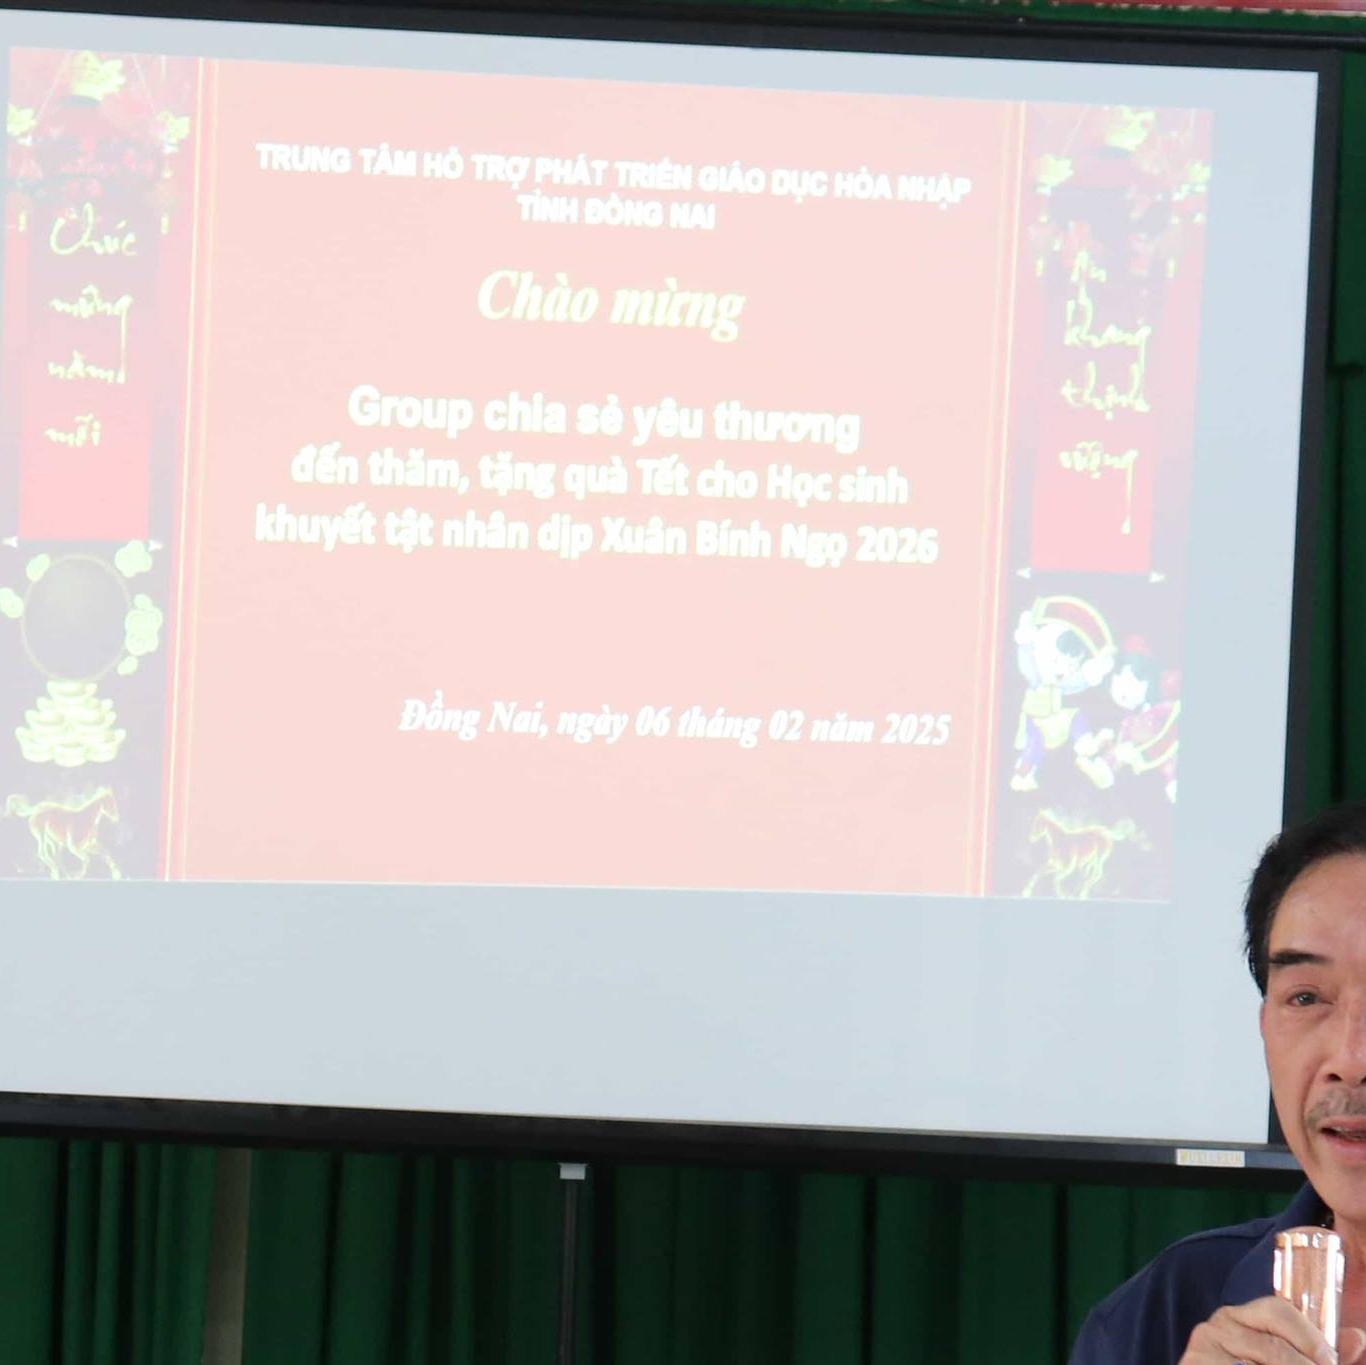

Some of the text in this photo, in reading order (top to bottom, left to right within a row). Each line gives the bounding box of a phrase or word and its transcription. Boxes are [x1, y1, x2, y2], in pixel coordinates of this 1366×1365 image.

[255, 142, 351, 173] TRUNG
[359, 142, 416, 177] TÂM
[471, 154, 530, 190] TRỢ
[535, 153, 608, 186] PHÁT
[699, 161, 765, 193] GIÁO
[771, 169, 828, 203] DỤC
[898, 171, 972, 210] NHẬP
[49, 201, 139, 256] Chúc
[670, 202, 716, 230] NAI
[477, 267, 745, 343] Chào mừng
[348, 385, 860, 454] Group chia sẻ yêu thương
[290, 441, 909, 507] đến thăm, tặng quà Tết cho Học sinh
[255, 502, 940, 568] khuyết tật nhân dịp Xuân Bính Ngọ 2026
[397, 689, 953, 748] Đồng Nai, ngày 06 tháng 02 năm 2025
